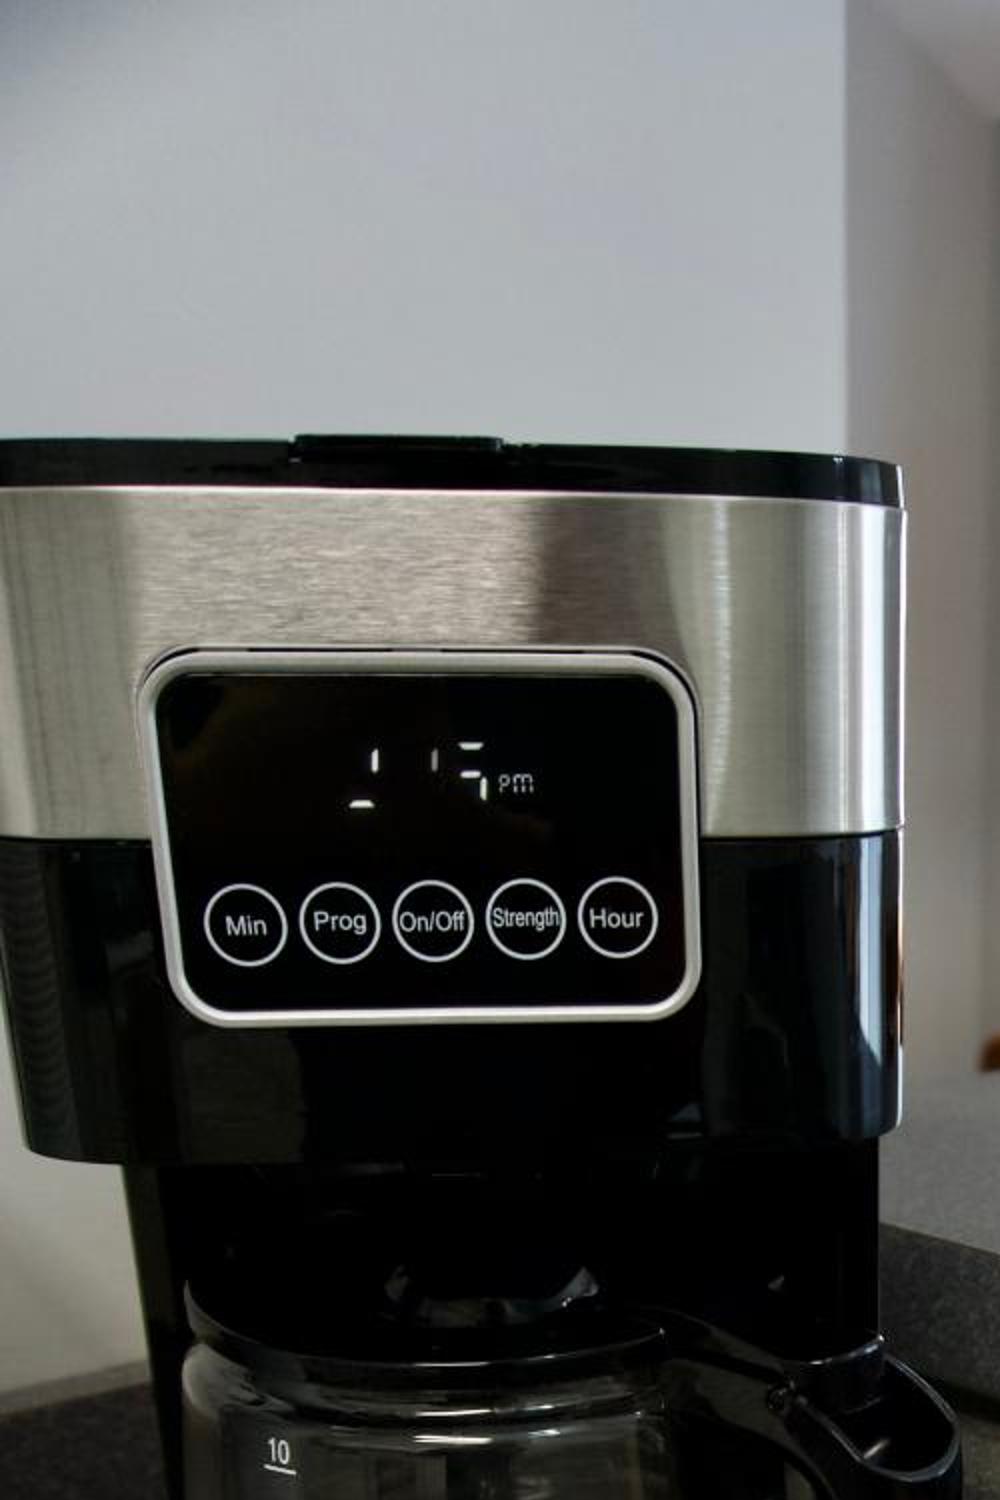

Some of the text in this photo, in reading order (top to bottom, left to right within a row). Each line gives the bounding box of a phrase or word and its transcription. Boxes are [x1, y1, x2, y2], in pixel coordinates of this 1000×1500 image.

[225, 915, 267, 936] Min
[314, 910, 367, 935] Prog
[399, 908, 466, 933] On/Off
[493, 906, 560, 929] Strength
[589, 908, 644, 930] Hour
[268, 1438, 290, 1465] 10
